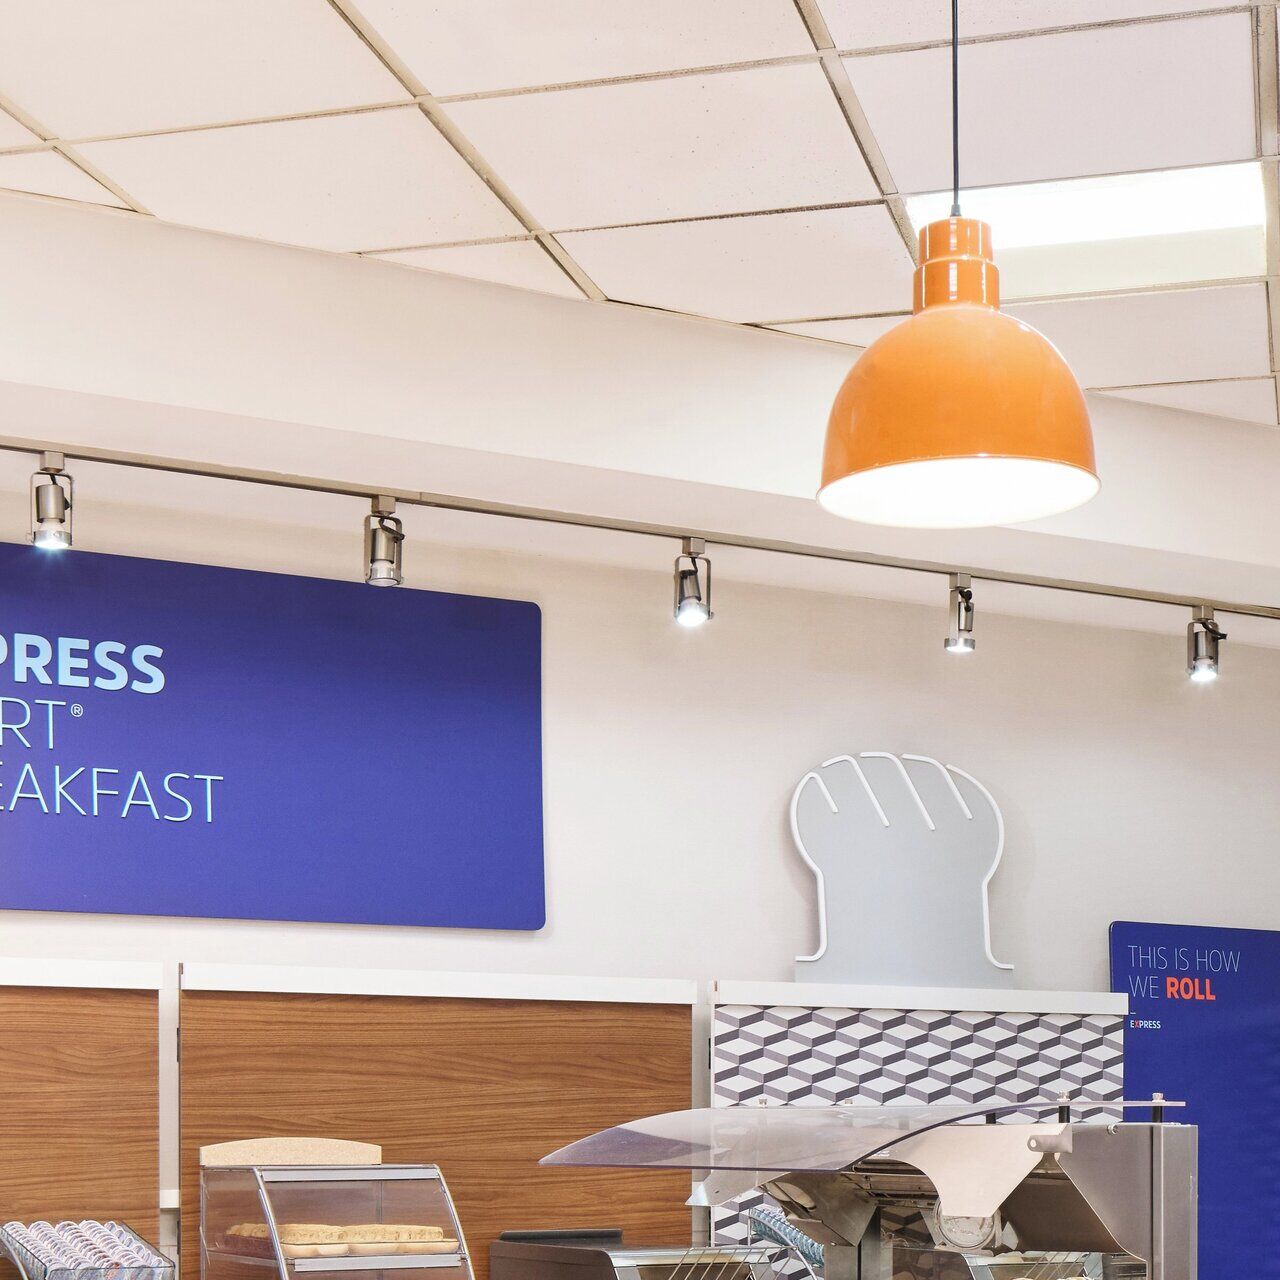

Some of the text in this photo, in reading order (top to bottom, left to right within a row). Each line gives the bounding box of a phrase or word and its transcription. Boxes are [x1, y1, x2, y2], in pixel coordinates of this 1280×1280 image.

[1128, 945, 1240, 973] THIS IS HOW
[1128, 975, 1216, 1001] WE ROLL
[1130, 1020, 1161, 1029] EXPRESS
